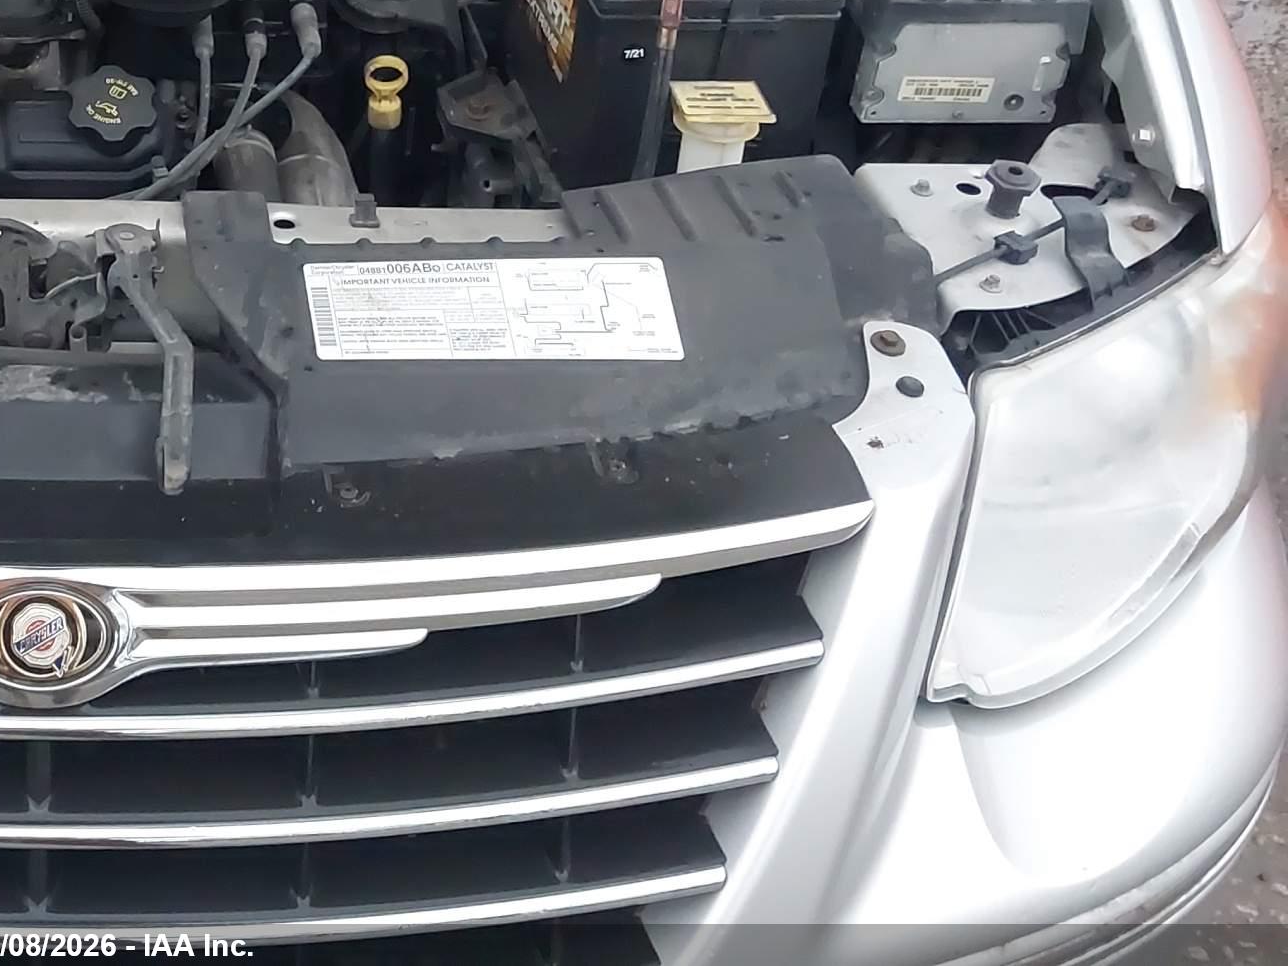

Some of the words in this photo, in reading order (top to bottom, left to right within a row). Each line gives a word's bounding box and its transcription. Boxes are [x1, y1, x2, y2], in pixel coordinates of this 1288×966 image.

[623, 48, 645, 59] 7/21
[92, 113, 121, 124] ENGINE
[445, 262, 494, 272] CATALYST
[340, 278, 391, 286] IMPORTANT
[392, 277, 426, 285] VEHICLE
[429, 276, 490, 284] INFORMATION
[18, 616, 64, 654] CHRYSLER
